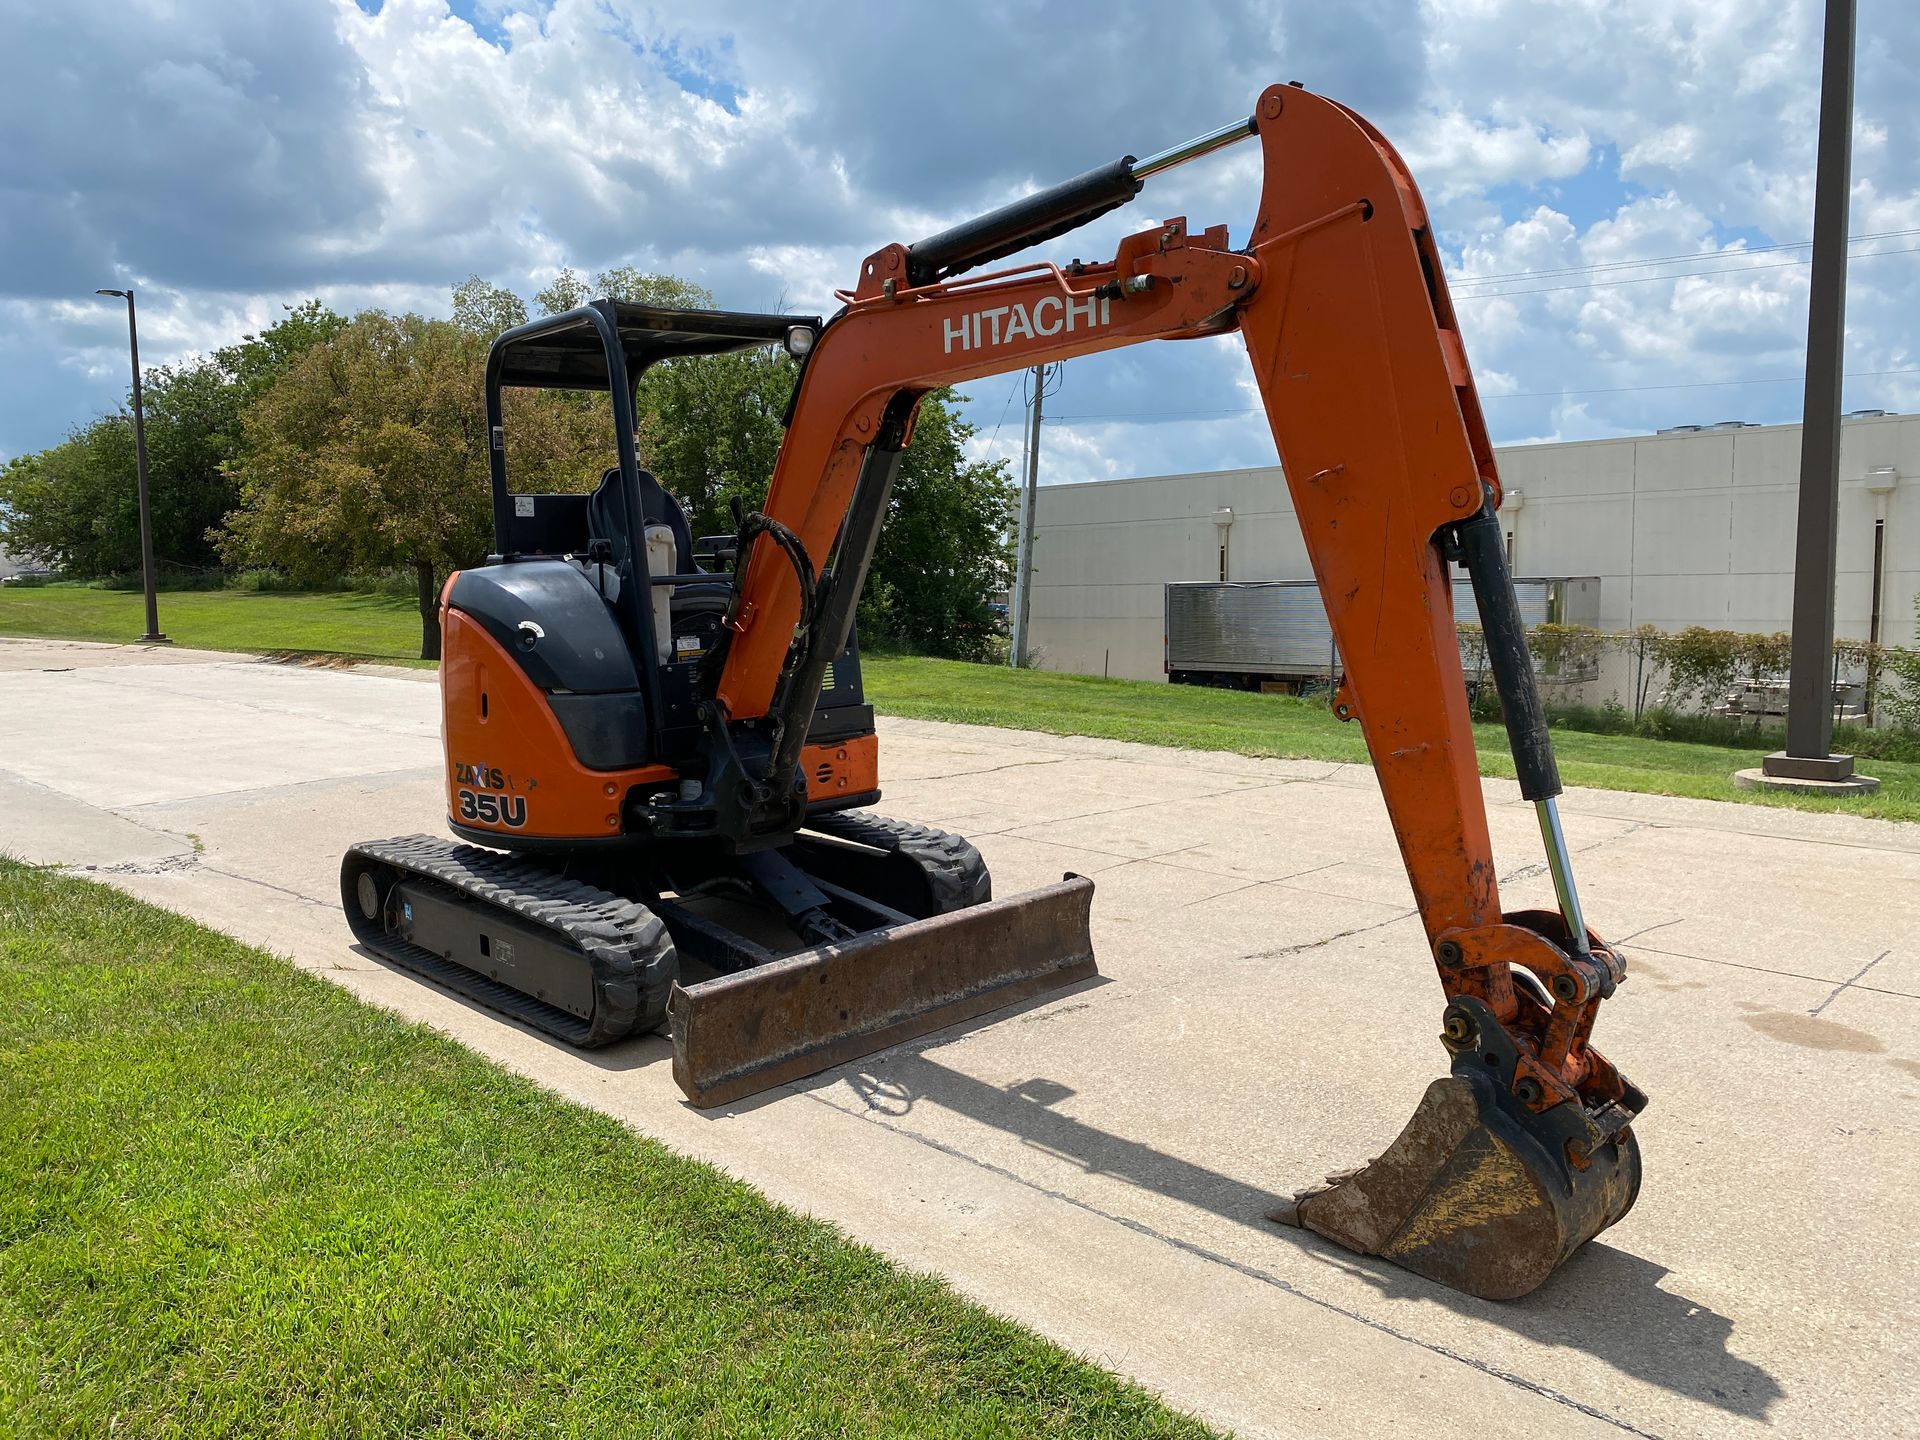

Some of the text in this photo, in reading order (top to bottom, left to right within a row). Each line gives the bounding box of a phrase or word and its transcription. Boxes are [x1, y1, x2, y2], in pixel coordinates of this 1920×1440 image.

[943, 296, 1111, 354] HITACHI
[456, 762, 505, 790] ZAXIS
[459, 789, 527, 828] 35U
